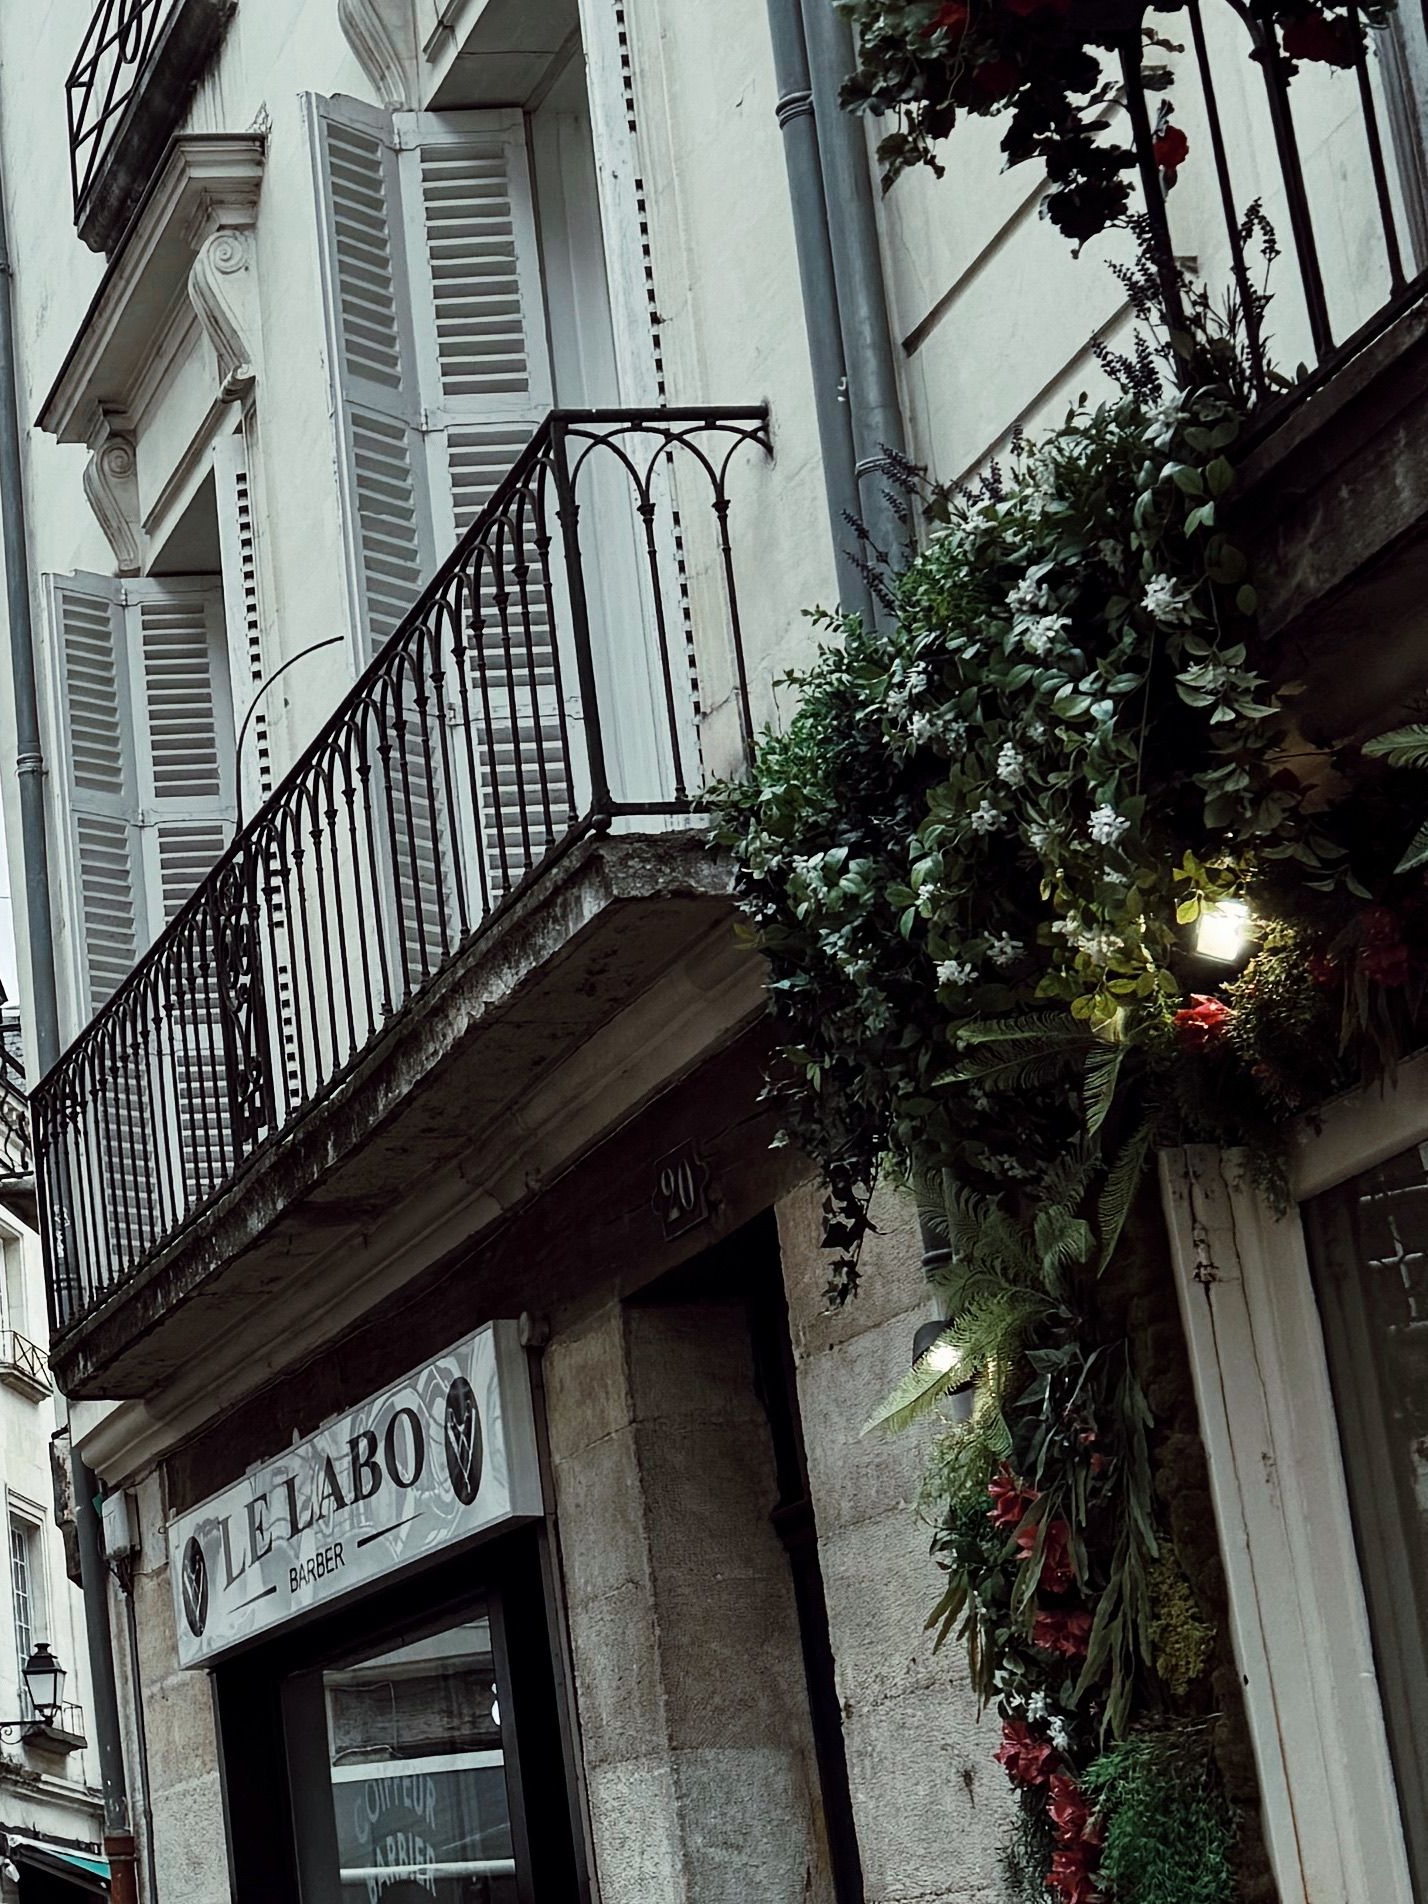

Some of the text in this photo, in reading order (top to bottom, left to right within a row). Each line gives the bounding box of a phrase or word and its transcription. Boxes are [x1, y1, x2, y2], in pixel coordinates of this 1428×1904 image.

[660, 1158, 695, 1222] 20
[217, 1407, 426, 1593] LE LABO
[288, 1541, 346, 1594] BARBER
